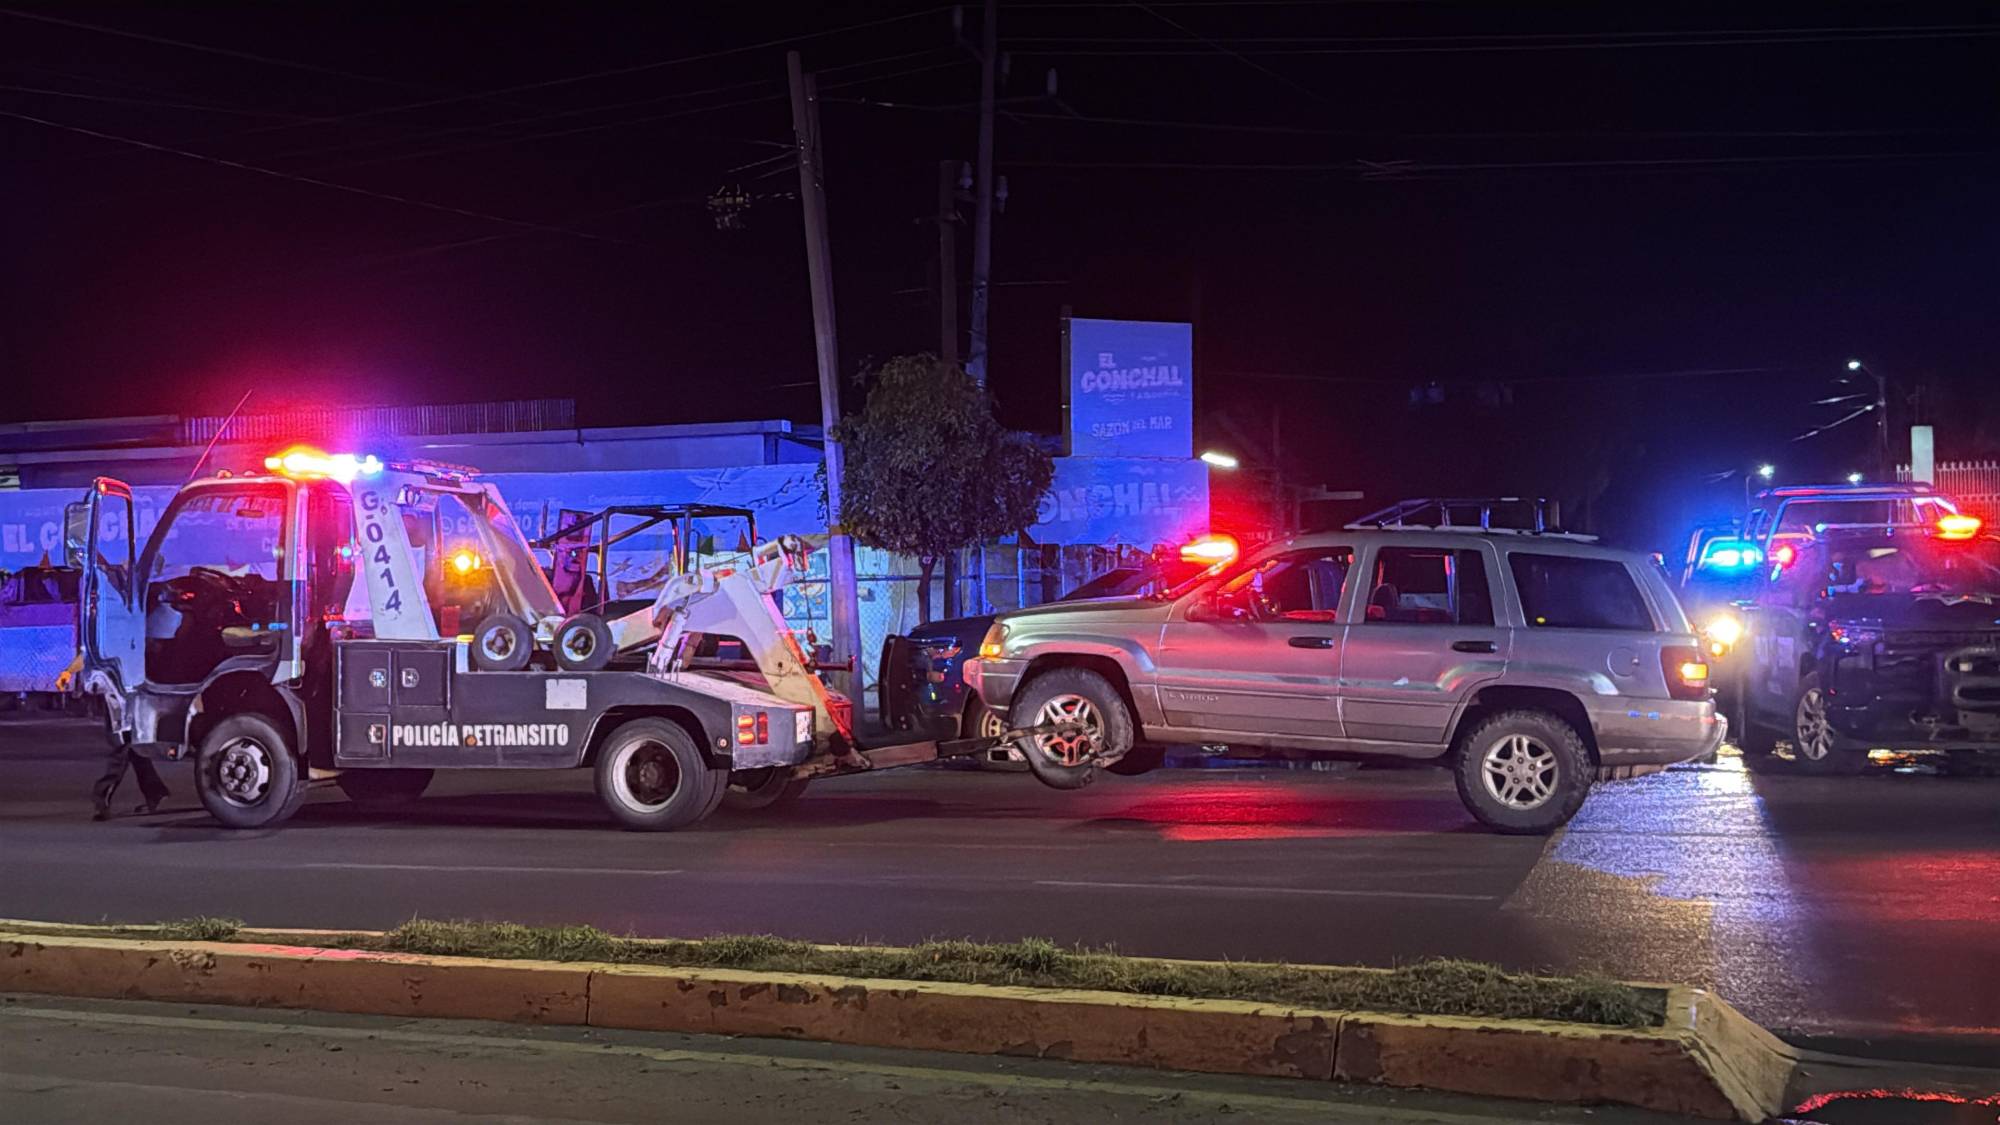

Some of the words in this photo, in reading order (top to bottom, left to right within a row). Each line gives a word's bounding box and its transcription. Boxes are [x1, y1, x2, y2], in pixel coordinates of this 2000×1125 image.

[1098, 353, 1116, 368] EL
[1081, 366, 1183, 393] CONCHAL
[1149, 416, 1173, 430] MAR
[2, 524, 34, 553] EL
[392, 721, 459, 746] POLICÍA
